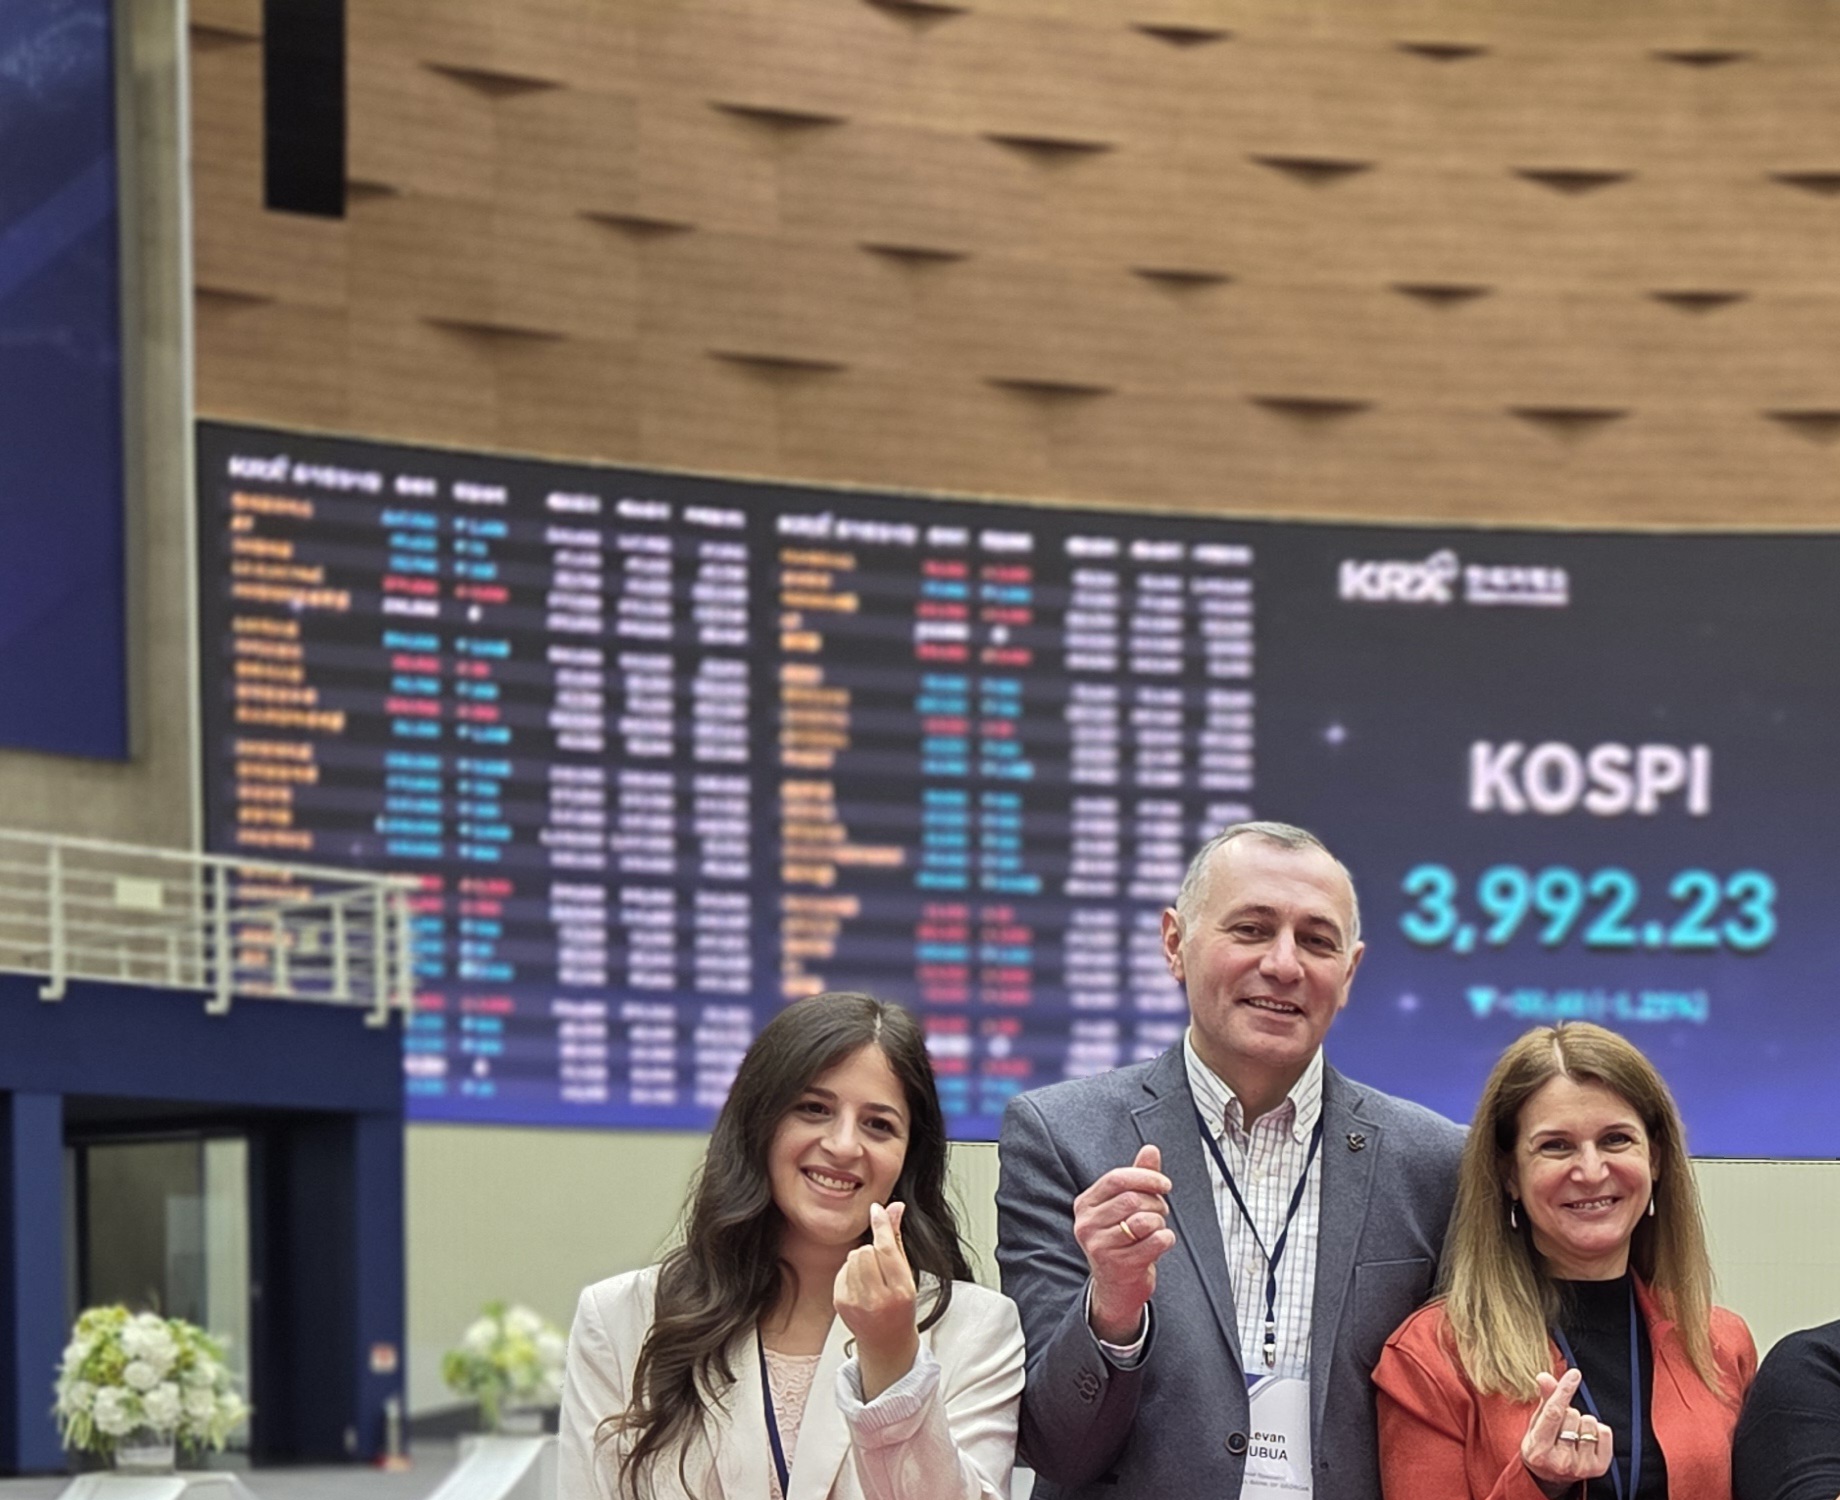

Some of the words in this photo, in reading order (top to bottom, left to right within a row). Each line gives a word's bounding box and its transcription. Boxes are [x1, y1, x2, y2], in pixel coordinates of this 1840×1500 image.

[1338, 554, 1456, 603] KRX
[1469, 742, 1711, 815] KOSPI
[1401, 866, 1778, 953] 3,992.23
[1249, 1431, 1286, 1444] evan
[1249, 1445, 1288, 1461] UBUA
